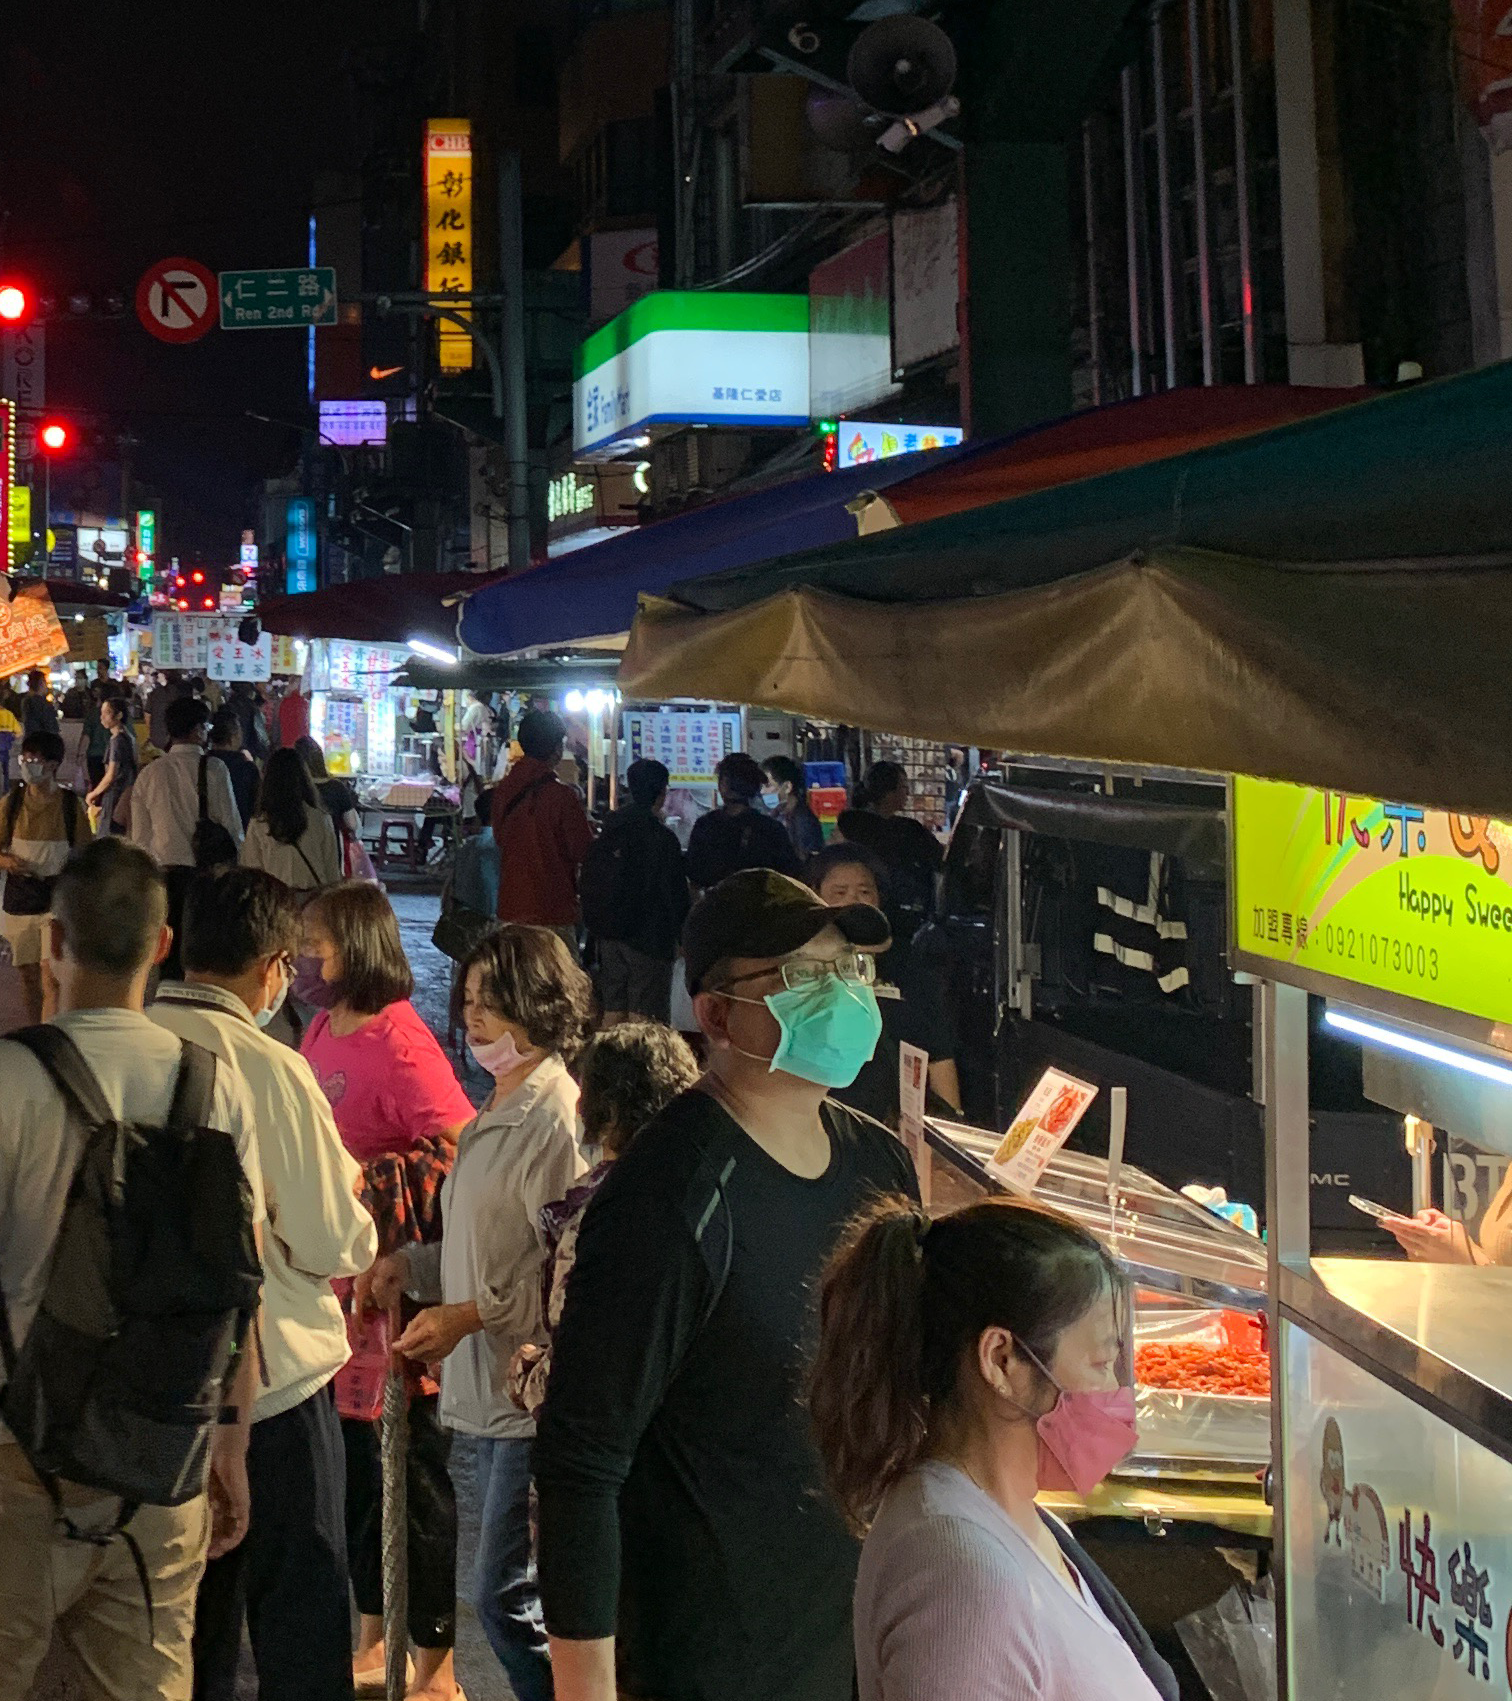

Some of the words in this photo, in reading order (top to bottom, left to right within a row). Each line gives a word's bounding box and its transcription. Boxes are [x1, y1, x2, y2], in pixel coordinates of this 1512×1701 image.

[436, 169, 466, 303] 彰化銀行
[234, 275, 321, 299] 仁二路
[235, 307, 262, 321] Ren
[266, 305, 294, 320] 2nd
[712, 387, 783, 402] 基隆仁愛店
[1399, 870, 1454, 928] Happy
[1325, 923, 1439, 982] 0921073003
[1310, 1172, 1351, 1187] MC
[1398, 1506, 1494, 1682] 快樂
